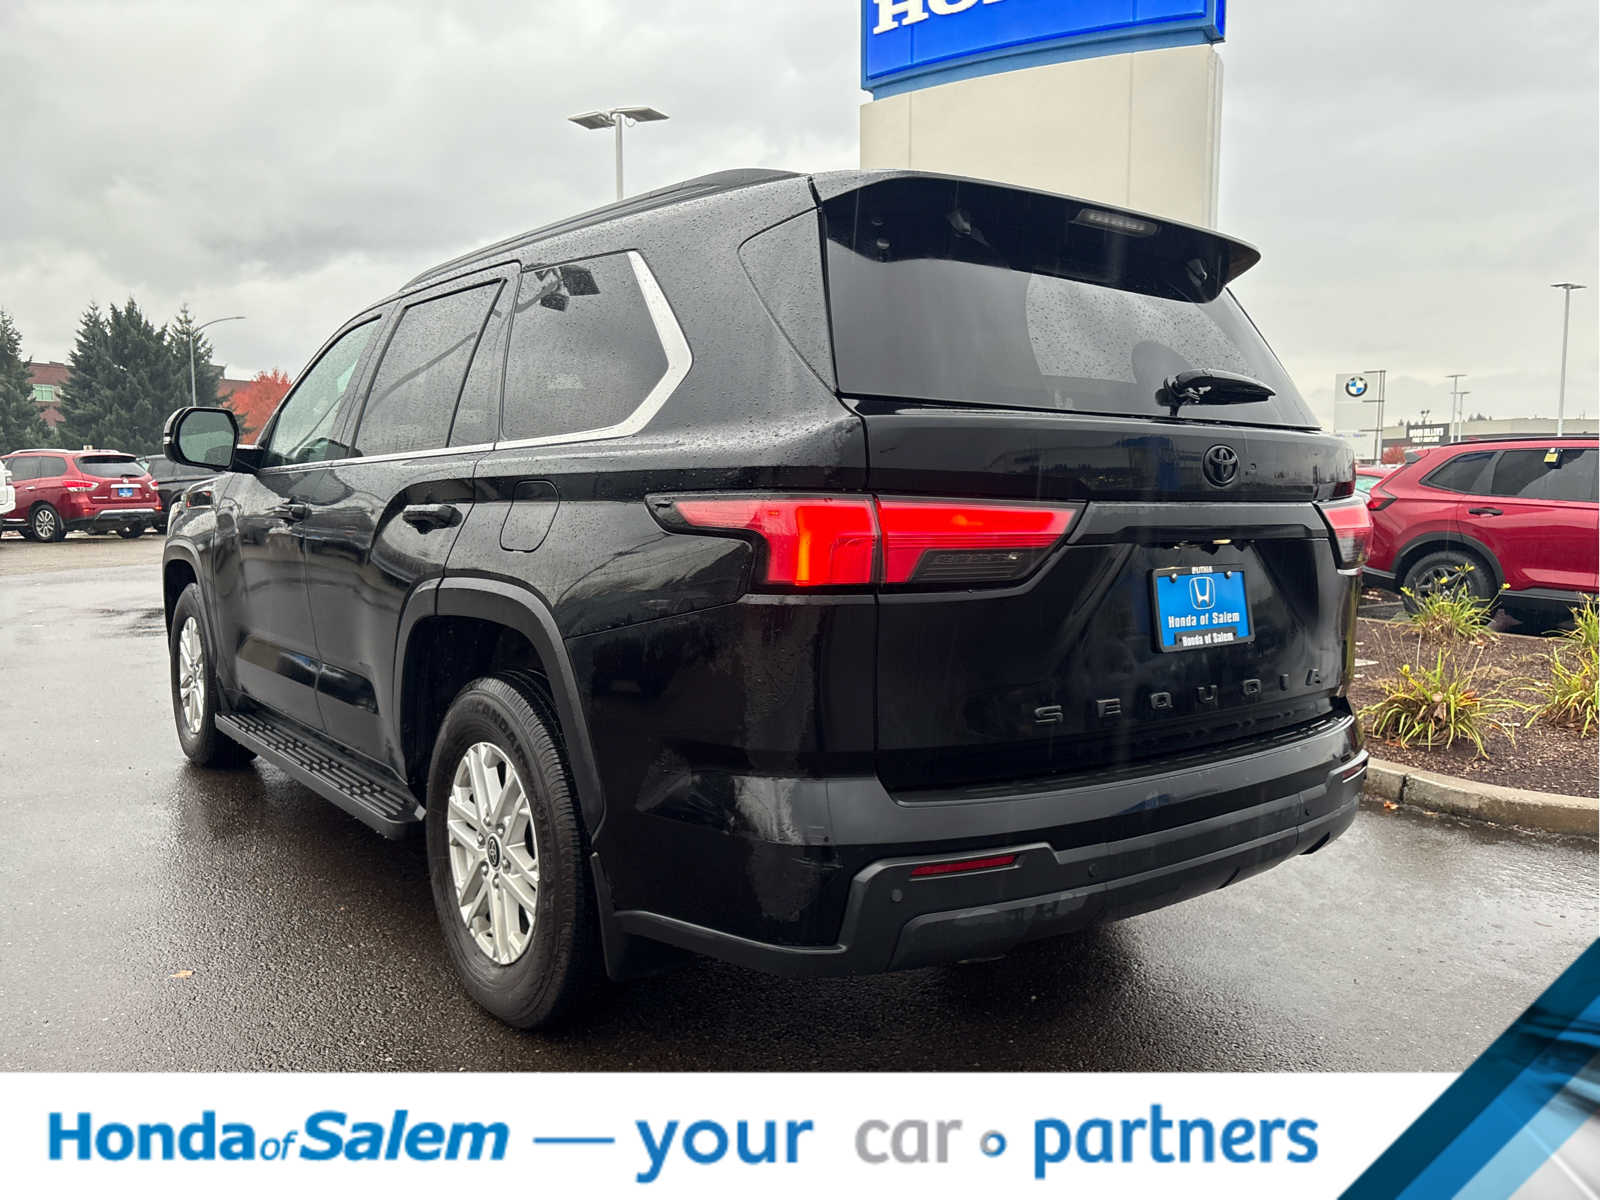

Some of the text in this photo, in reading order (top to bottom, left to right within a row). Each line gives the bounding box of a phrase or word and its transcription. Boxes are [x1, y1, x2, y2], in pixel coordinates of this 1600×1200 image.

[1168, 611, 1240, 629] Honda of Salem
[1181, 632, 1234, 647] Honda of Salem
[1033, 668, 1322, 724] SEQUOIA
